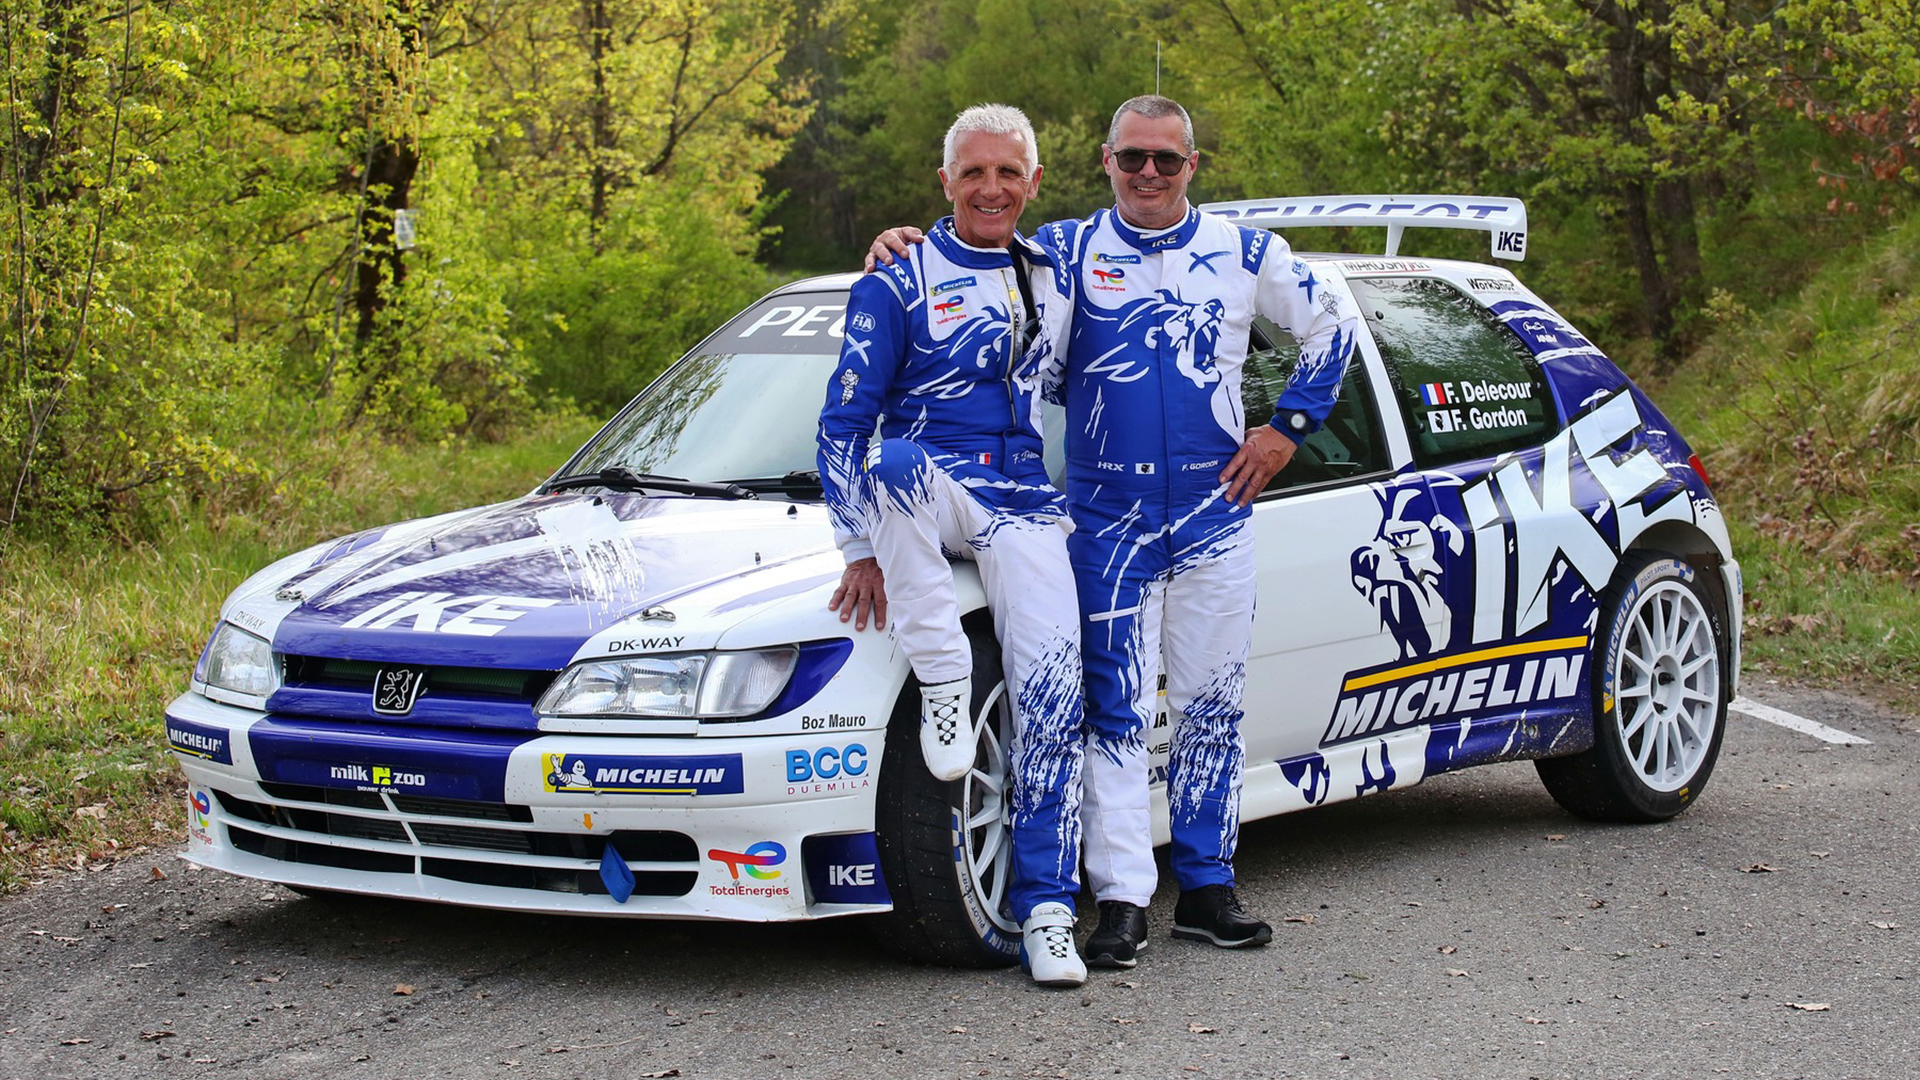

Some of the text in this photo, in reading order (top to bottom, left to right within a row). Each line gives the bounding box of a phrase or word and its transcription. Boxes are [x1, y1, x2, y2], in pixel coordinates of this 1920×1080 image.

[1052, 224, 1069, 253] HRX
[1247, 230, 1265, 263] HRX
[1497, 231, 1524, 252] iKE
[1092, 284, 1126, 292] TotalEnergies
[853, 313, 871, 329] FIA
[1443, 380, 1531, 404] F. Delecour
[1451, 406, 1527, 432] F. Gordon
[1097, 461, 1125, 471] HRX
[1189, 459, 1218, 471] GORDON
[1462, 389, 1695, 644] iKE
[1639, 564, 1670, 584] PILOT SPORT
[340, 591, 562, 636] iKE
[1606, 588, 1635, 675] MICHELIN
[608, 636, 685, 652] DK-WAY
[1324, 654, 1584, 743] MICHELIN
[801, 714, 866, 730] Boz Mauro
[170, 729, 222, 752] MICHELIN
[785, 743, 868, 783] BCC
[331, 765, 426, 786] milk zoo
[595, 767, 725, 784] MICHELIN
[788, 780, 869, 795] DUEMILA
[829, 863, 876, 886] iKE
[709, 885, 790, 898] TotalEnergies
[988, 932, 1021, 955] HELIN
